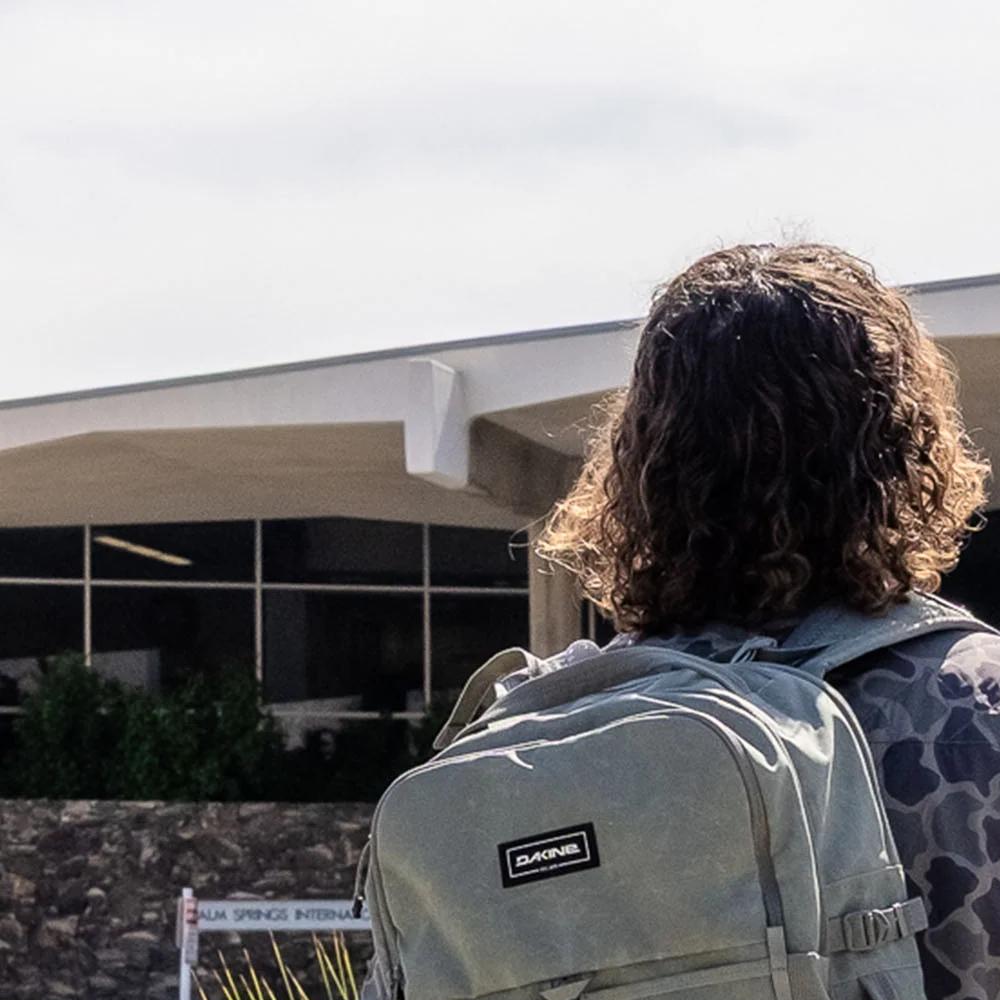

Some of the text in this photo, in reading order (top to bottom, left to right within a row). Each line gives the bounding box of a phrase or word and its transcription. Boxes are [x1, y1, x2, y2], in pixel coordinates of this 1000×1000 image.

[515, 843, 581, 867] DAKINE
[200, 908, 227, 921] ALM
[233, 908, 288, 921] SPRINGS
